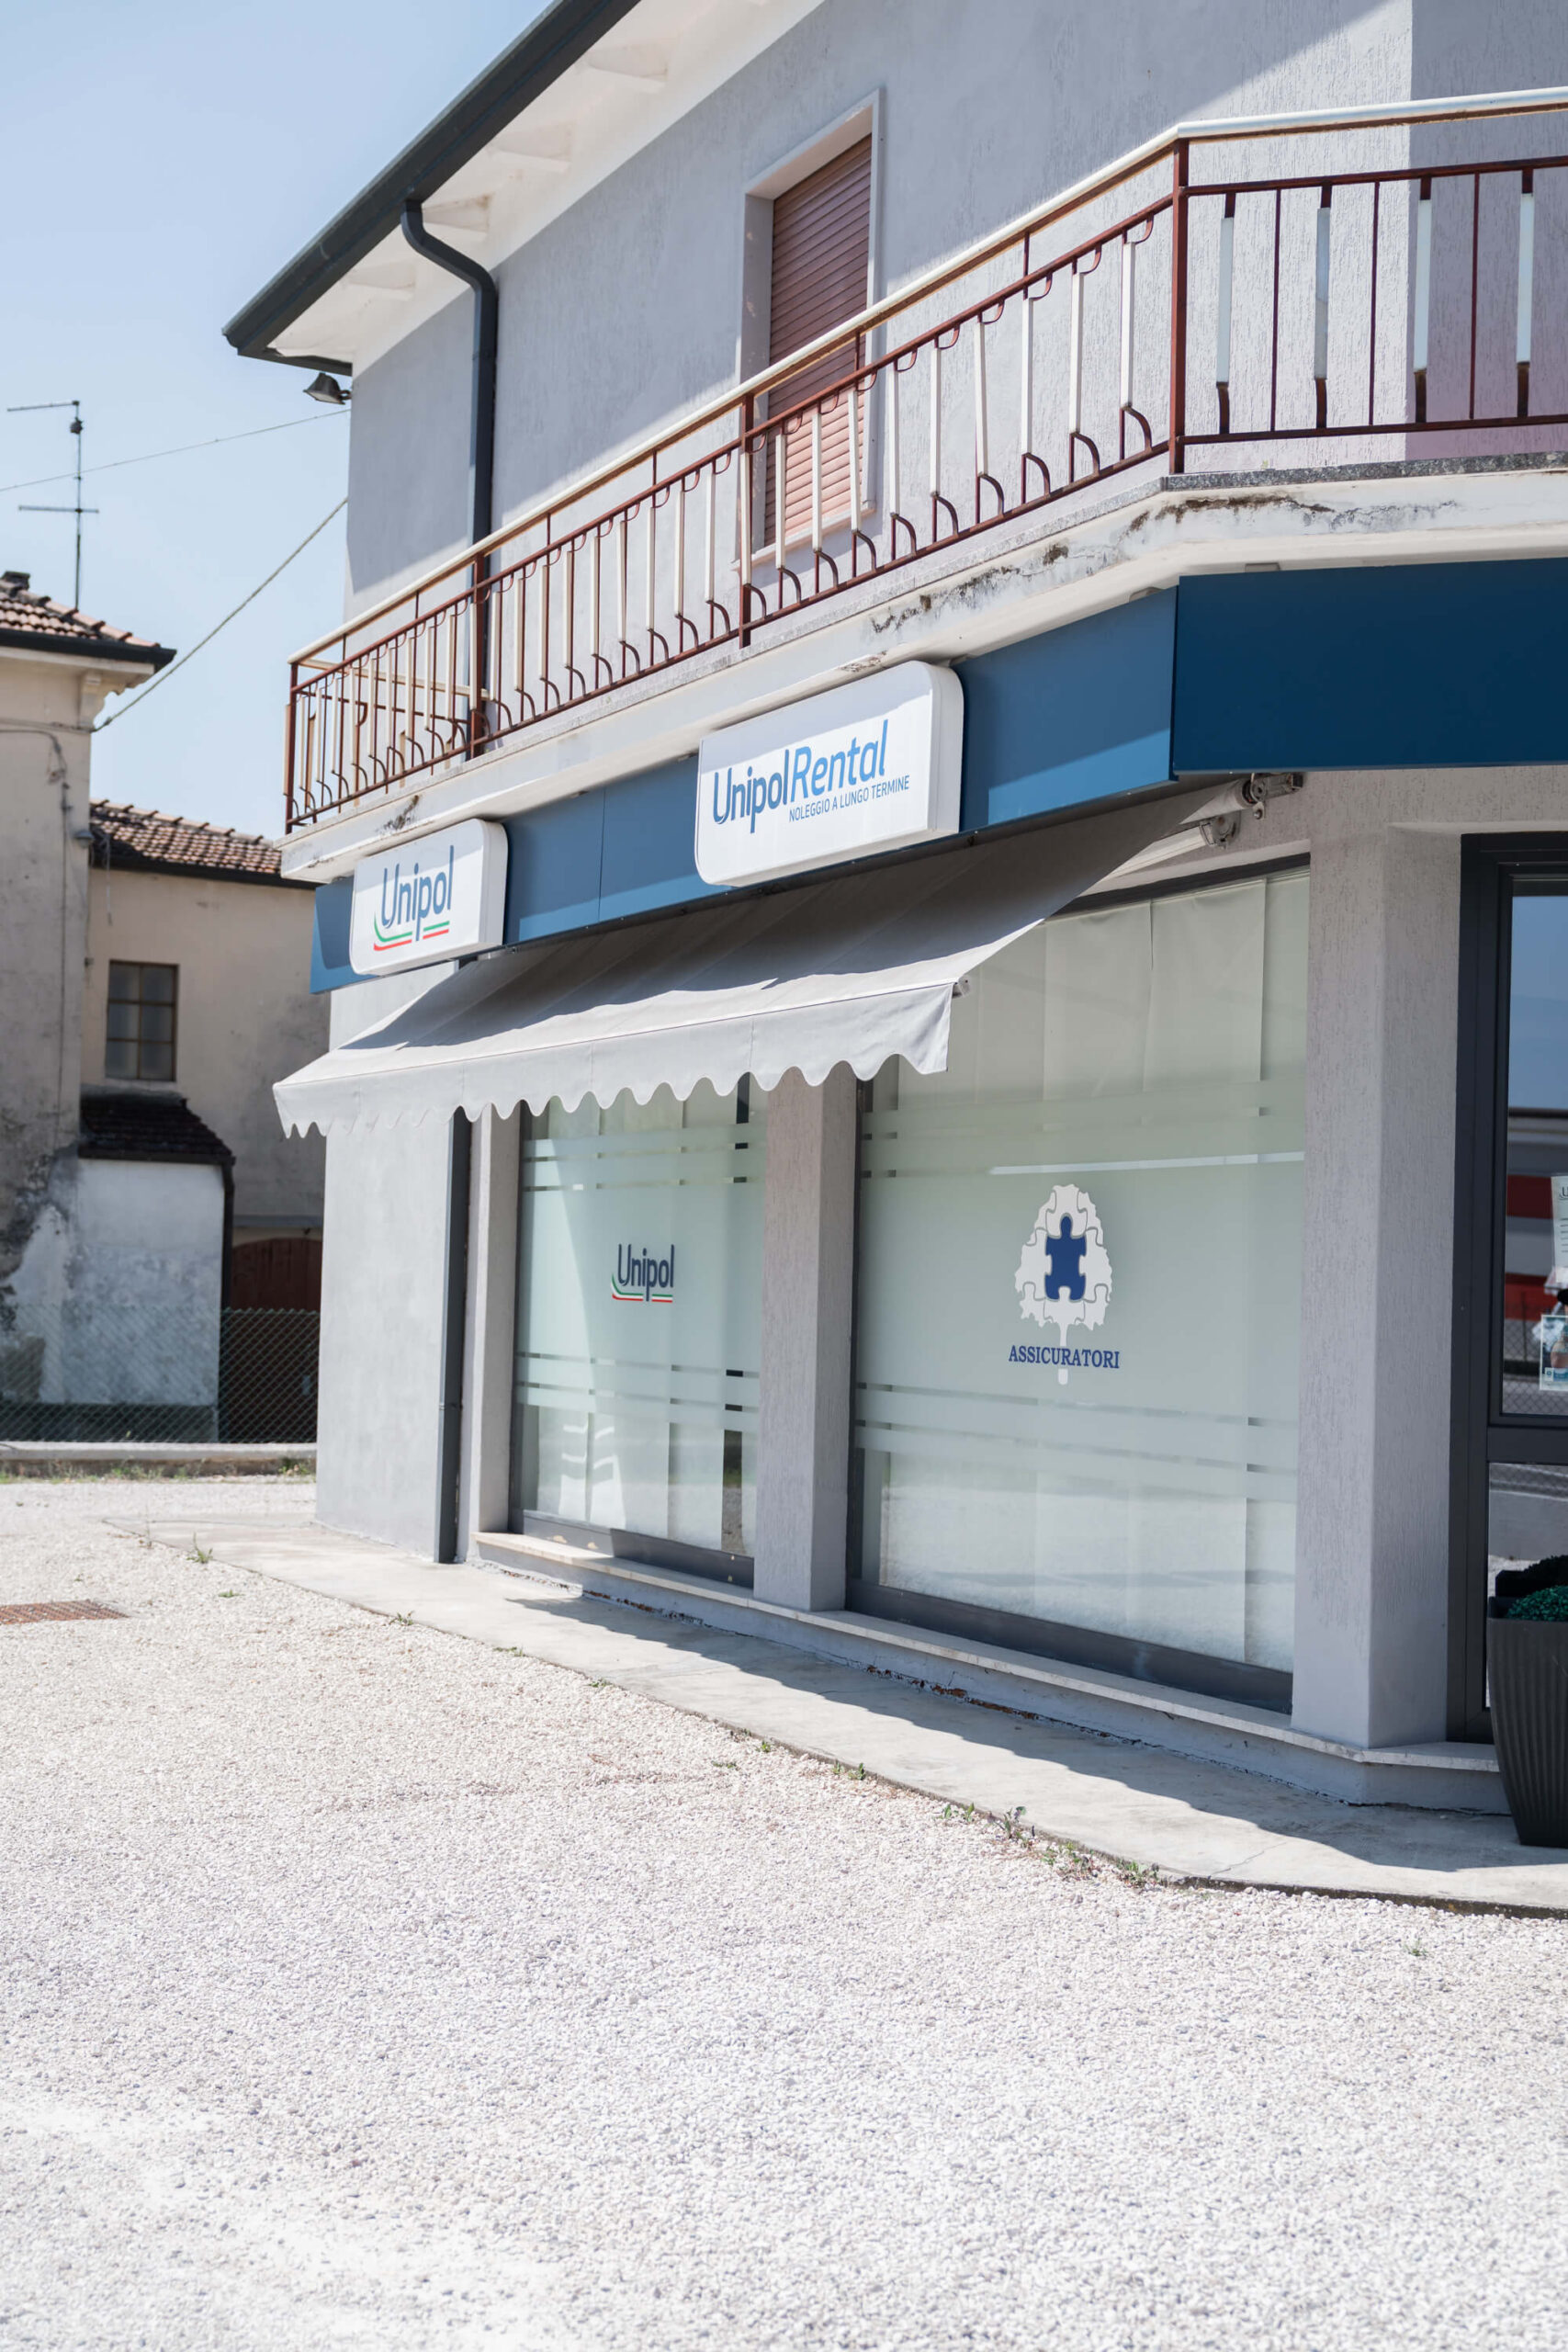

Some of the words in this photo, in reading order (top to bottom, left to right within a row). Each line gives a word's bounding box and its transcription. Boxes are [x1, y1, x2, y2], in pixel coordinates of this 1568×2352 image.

[713, 719, 888, 833] UnipolRental
[789, 798, 829, 822] NOLEGGIO
[831, 796, 838, 810] A
[840, 787, 869, 808] LUNGO
[871, 775, 909, 799] TERMINE
[381, 845, 454, 941] Unipol
[617, 1243, 674, 1302] Unipol
[1009, 1345, 1120, 1369] ASSICURATORI
